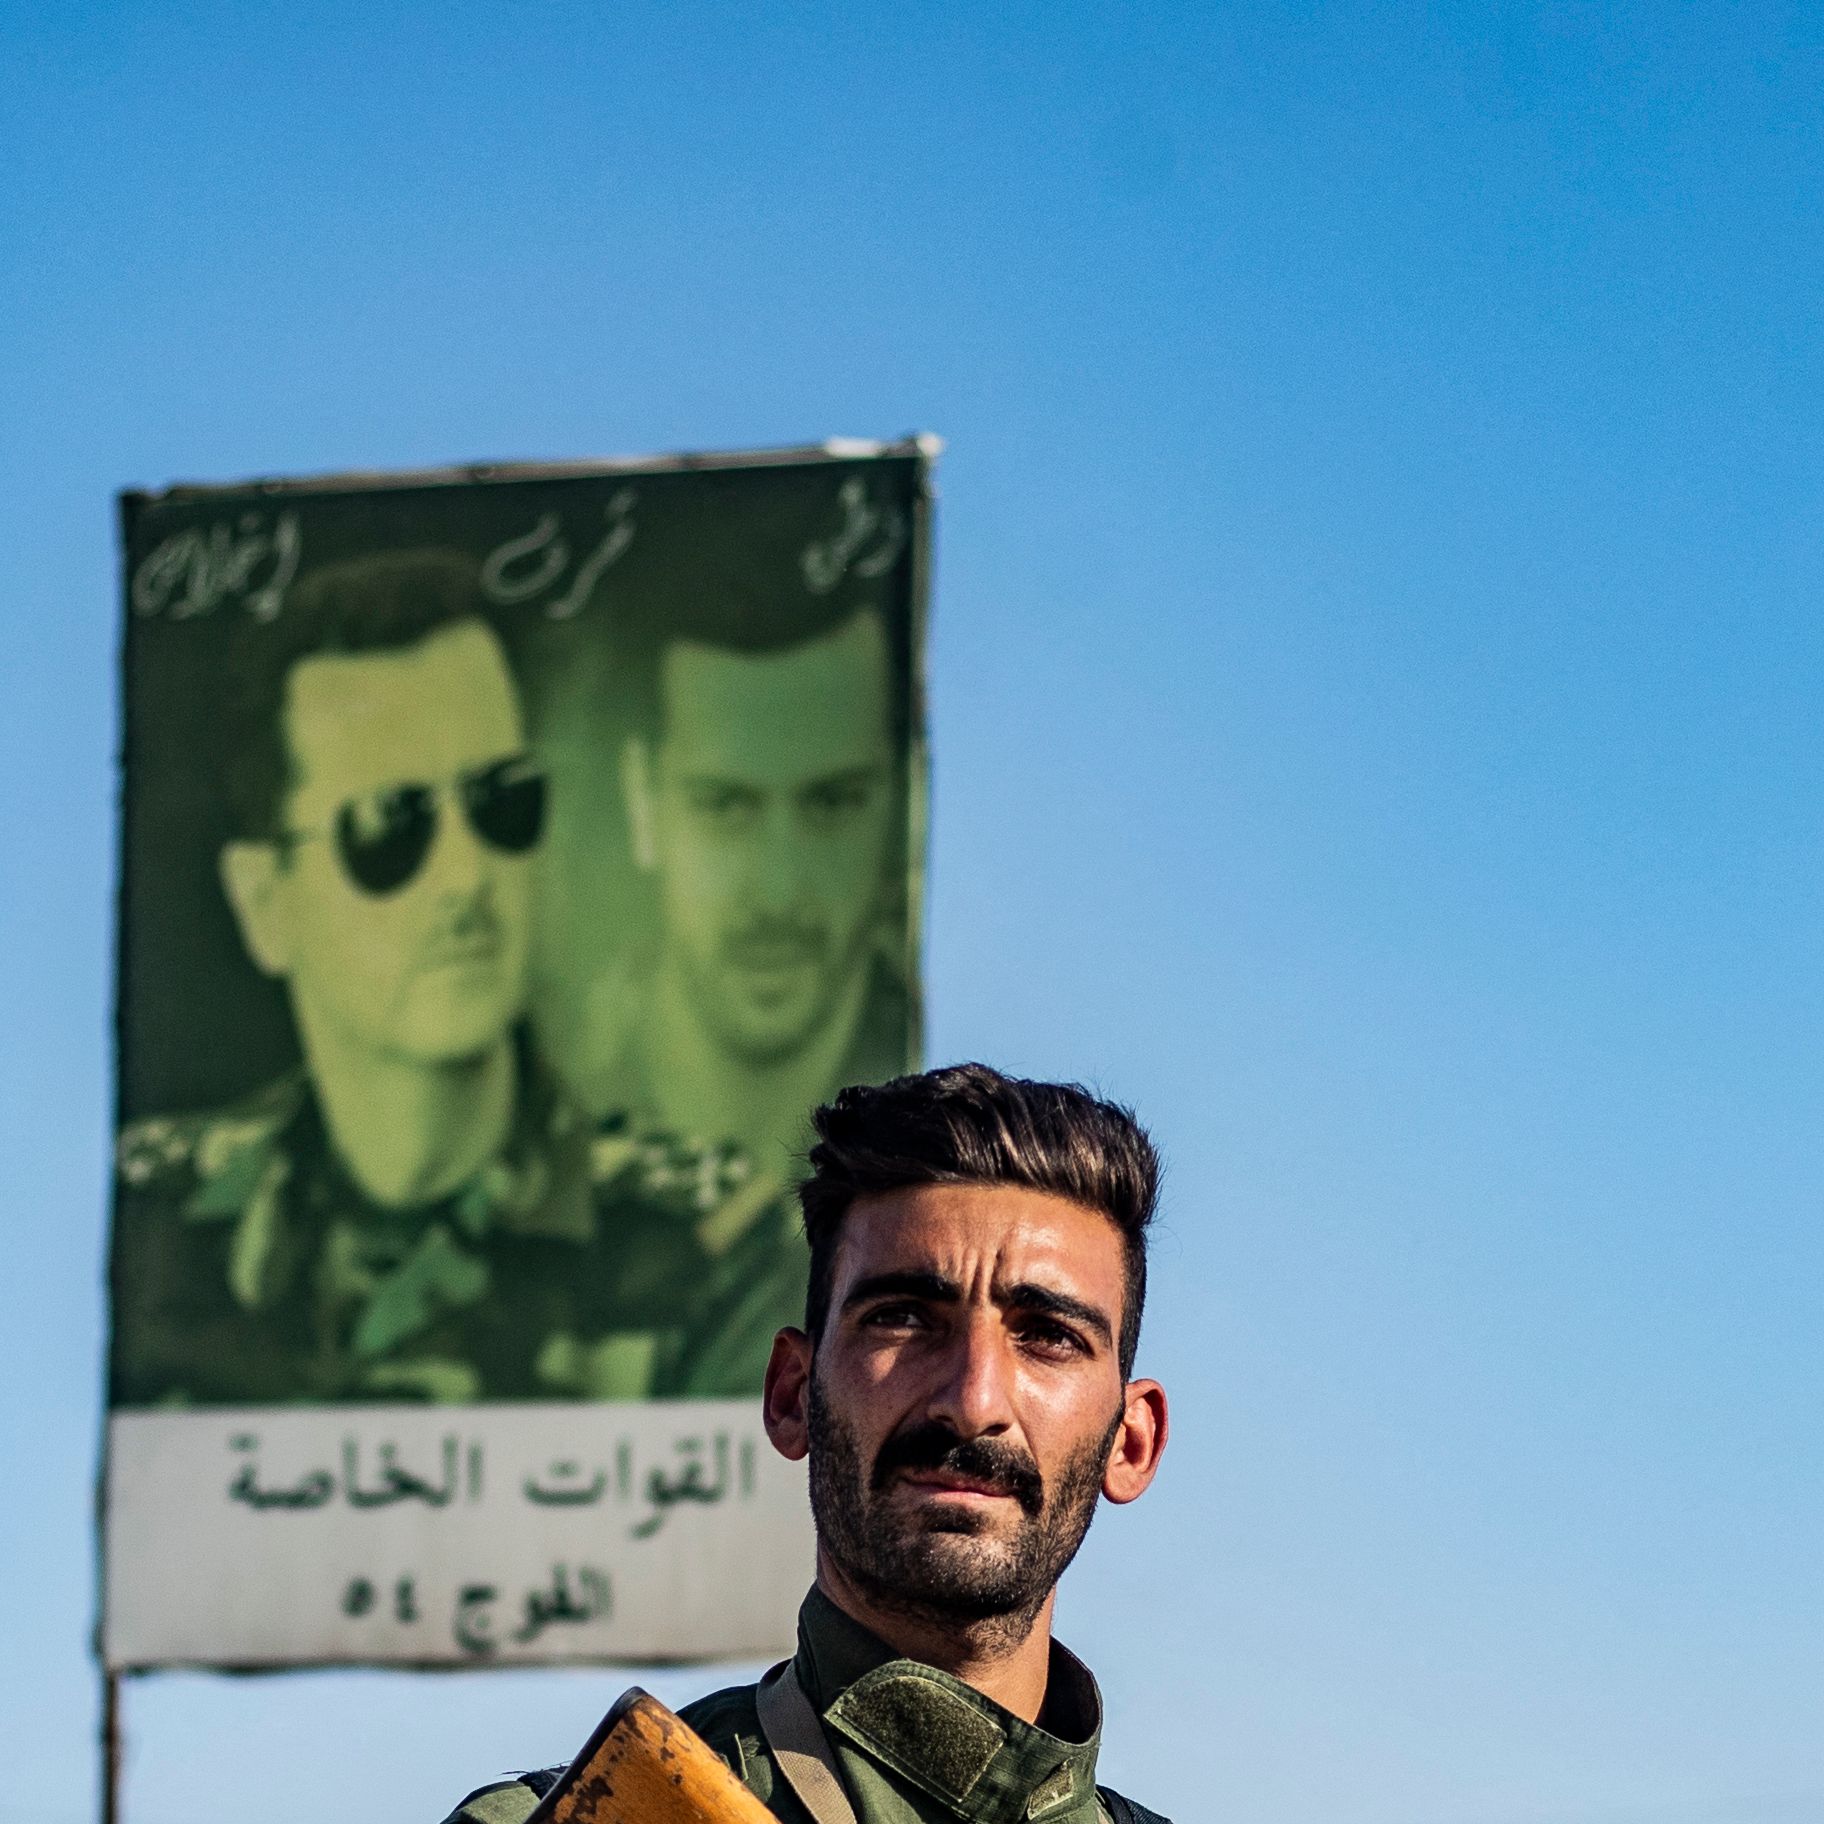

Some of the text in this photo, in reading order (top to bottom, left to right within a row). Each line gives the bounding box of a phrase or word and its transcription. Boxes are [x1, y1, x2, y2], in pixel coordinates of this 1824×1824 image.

[228, 1431, 755, 1539] القوات الخاصة
[342, 1563, 613, 1652] الفوج ٥٤
